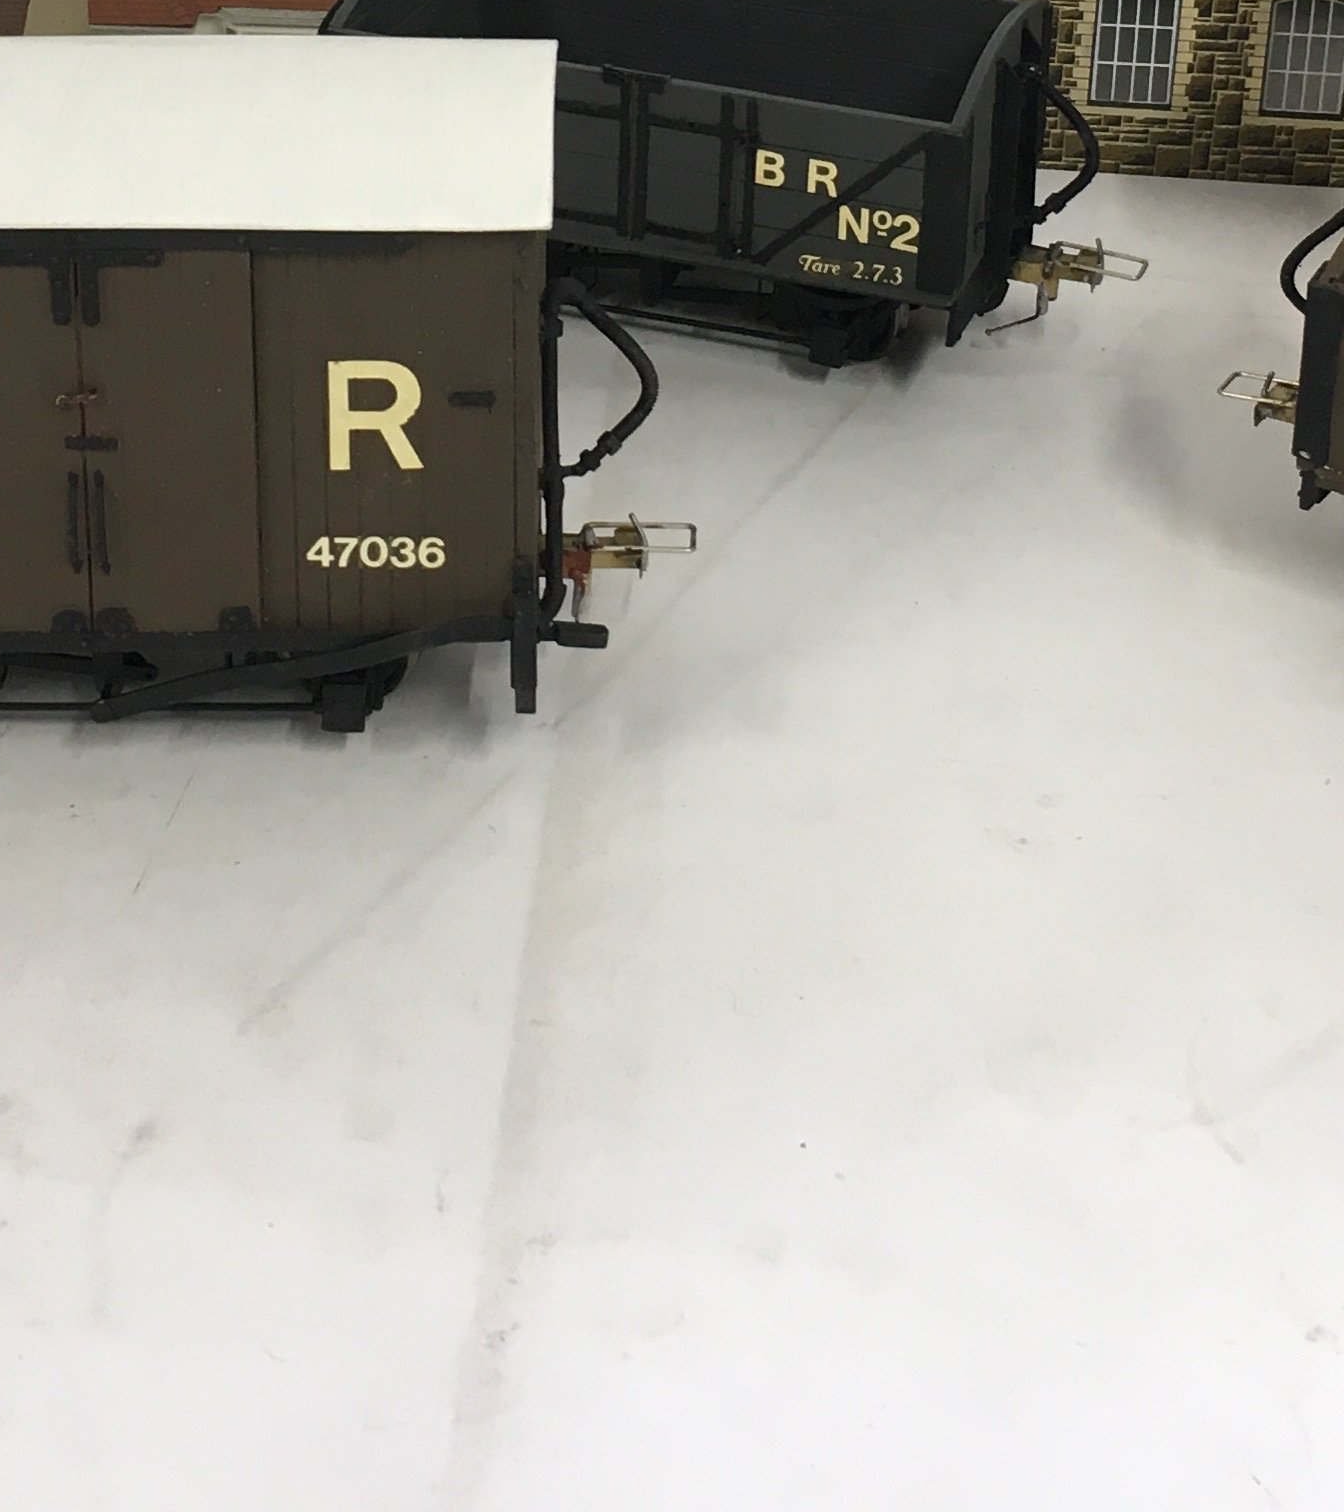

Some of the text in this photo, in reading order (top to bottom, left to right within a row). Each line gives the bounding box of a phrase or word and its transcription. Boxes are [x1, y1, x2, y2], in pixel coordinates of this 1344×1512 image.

[798, 254, 903, 286] Tare 2.7.3
[327, 360, 425, 471] R
[306, 535, 446, 569] 47036
